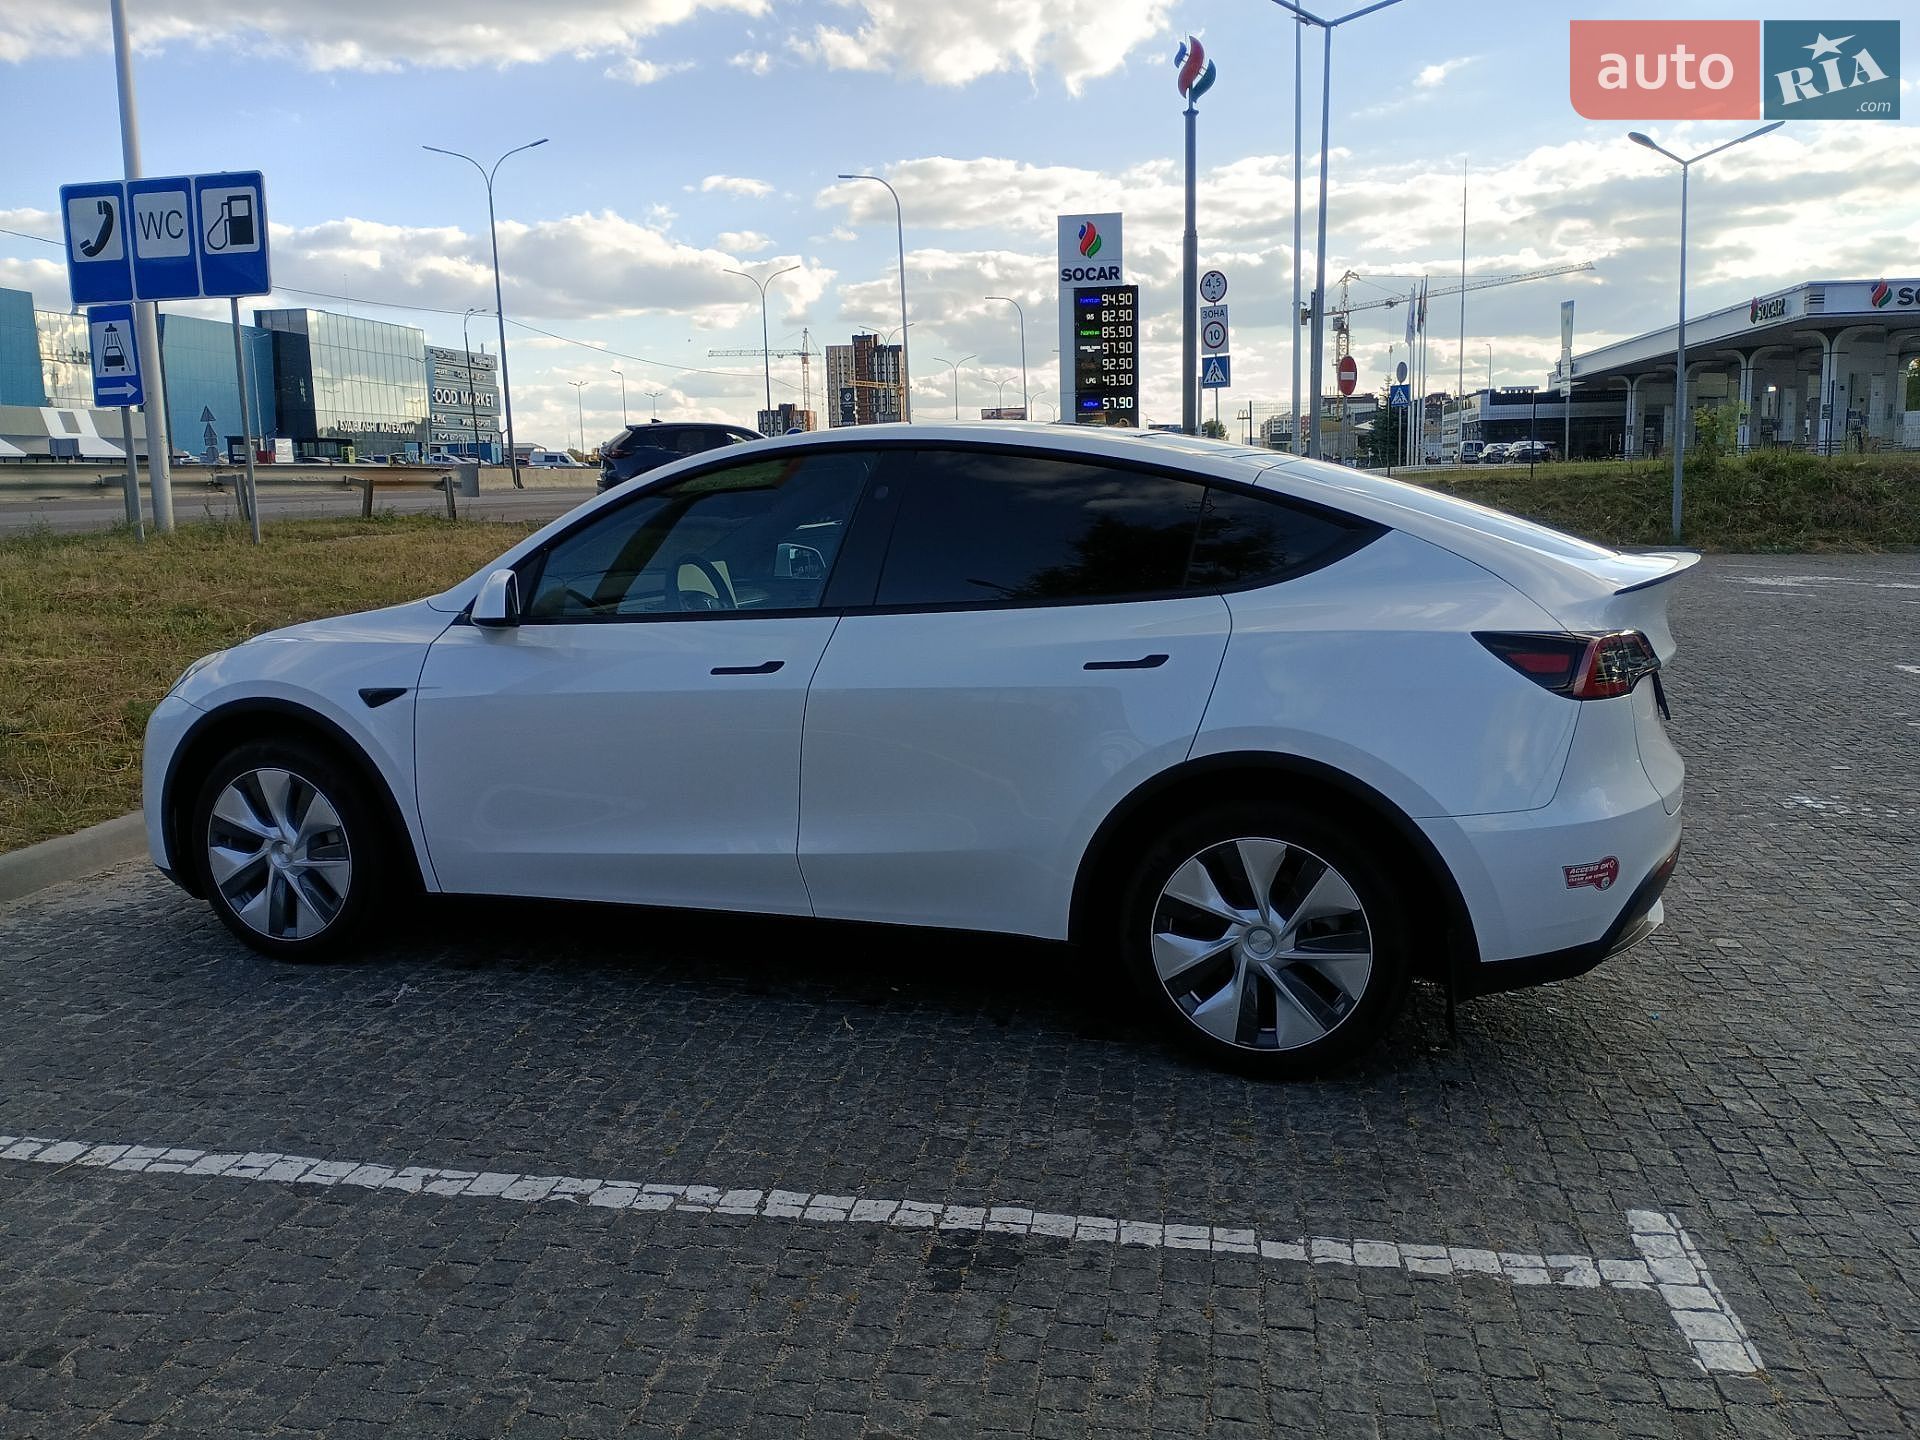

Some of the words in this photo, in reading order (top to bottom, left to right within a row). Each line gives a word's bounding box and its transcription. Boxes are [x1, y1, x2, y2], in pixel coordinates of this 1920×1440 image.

[139, 210, 184, 240] WC
[1061, 266, 1120, 282] SOCAR
[1101, 293, 1133, 306] 94.90
[1101, 309, 1133, 322] 82.90
[1202, 310, 1225, 319] ЗОНА
[1101, 325, 1133, 338] 85.90
[1209, 330, 1221, 341] 10
[1102, 341, 1133, 354] 97.90
[1102, 357, 1133, 370] 92.90
[1102, 373, 1133, 386] 43.90
[460, 390, 494, 408] MARKET
[1102, 396, 1133, 409] 57.90
